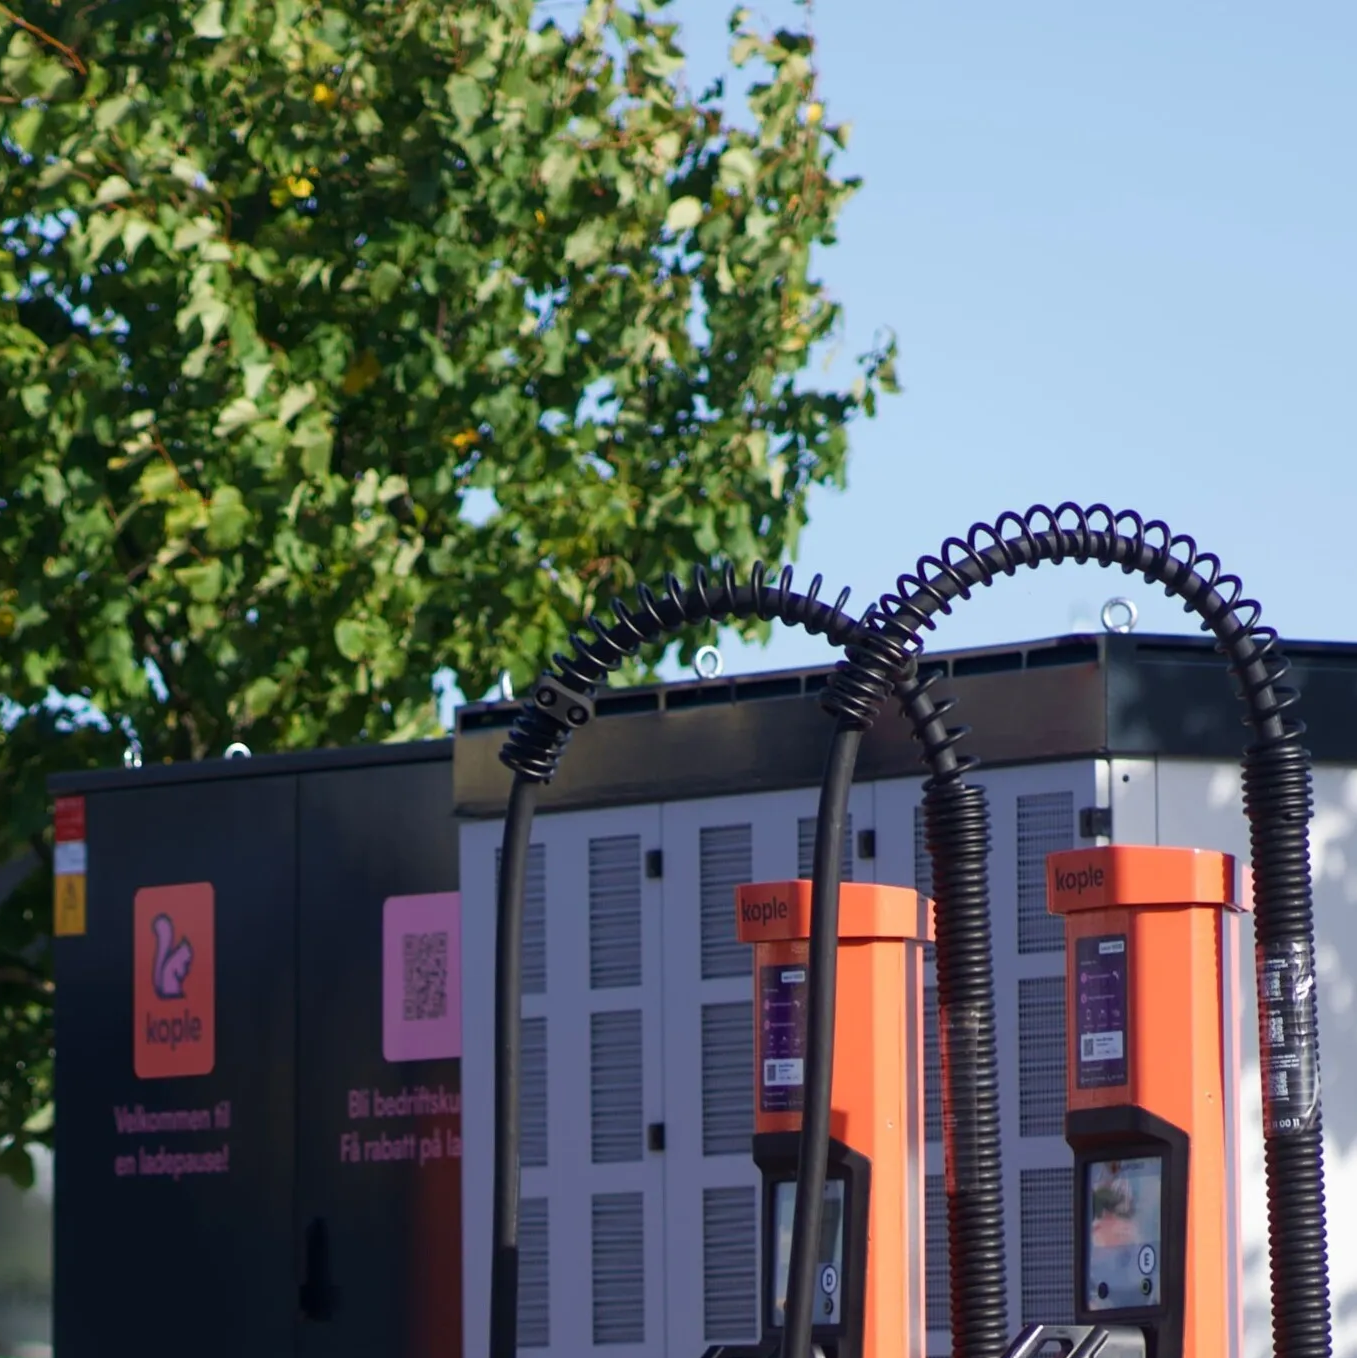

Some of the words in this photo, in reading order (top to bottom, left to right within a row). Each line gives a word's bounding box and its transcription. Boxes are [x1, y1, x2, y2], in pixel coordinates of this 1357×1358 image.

[1054, 863, 1105, 894] kople
[741, 896, 788, 926] kople
[145, 1008, 203, 1051] kople
[113, 1103, 211, 1134] Velkommen
[115, 1155, 137, 1177] en
[139, 1142, 230, 1181] ladepause!
[364, 1130, 416, 1162] rabatt
[420, 1126, 443, 1168] på
